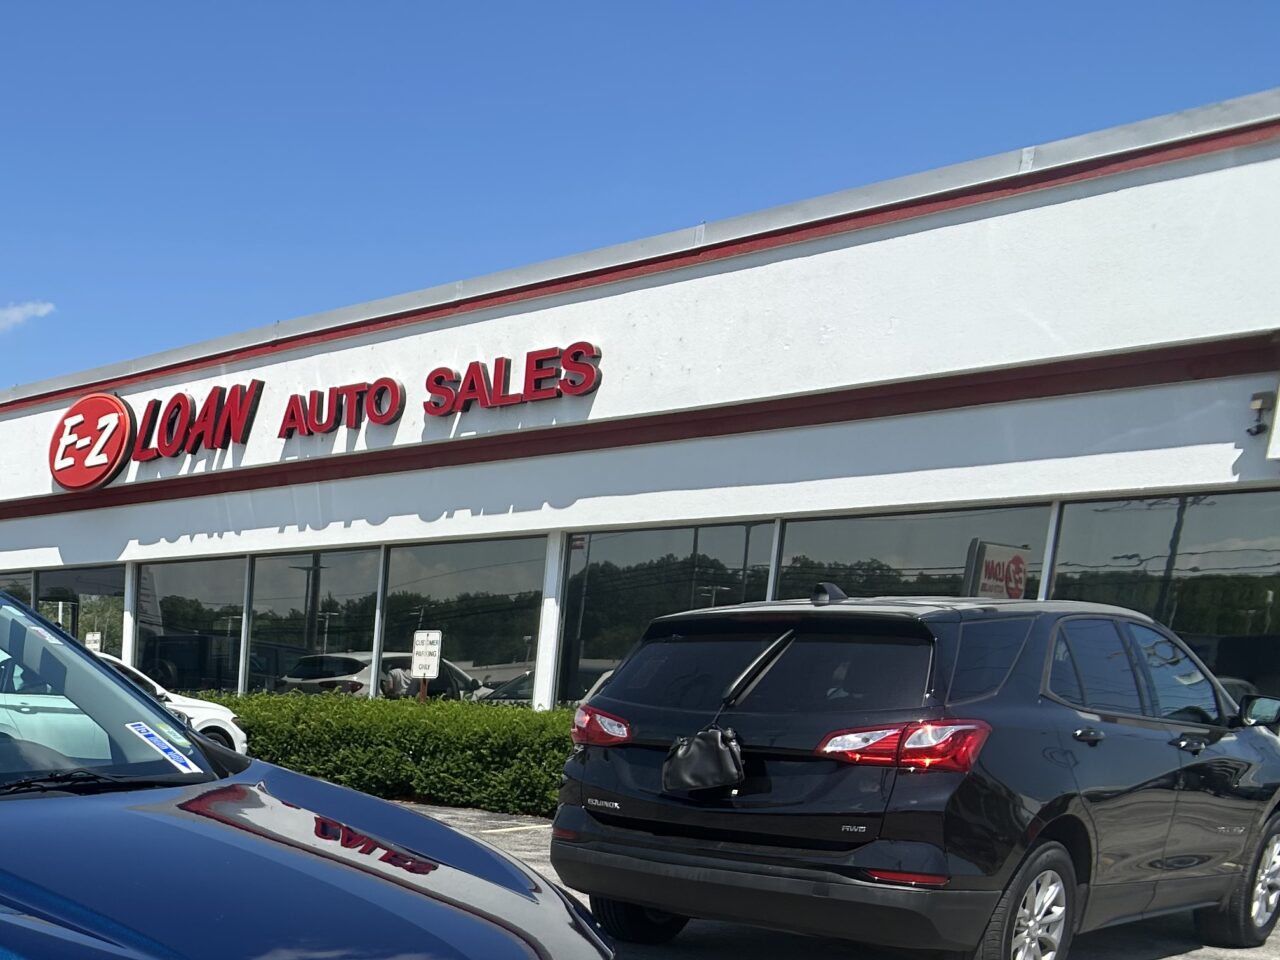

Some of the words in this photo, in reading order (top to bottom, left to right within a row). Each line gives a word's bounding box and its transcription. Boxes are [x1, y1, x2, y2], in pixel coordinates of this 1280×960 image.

[54, 413, 119, 471] E-Z
[132, 380, 265, 462] LOAN
[277, 377, 406, 439] AUTO
[422, 341, 602, 416] SALES
